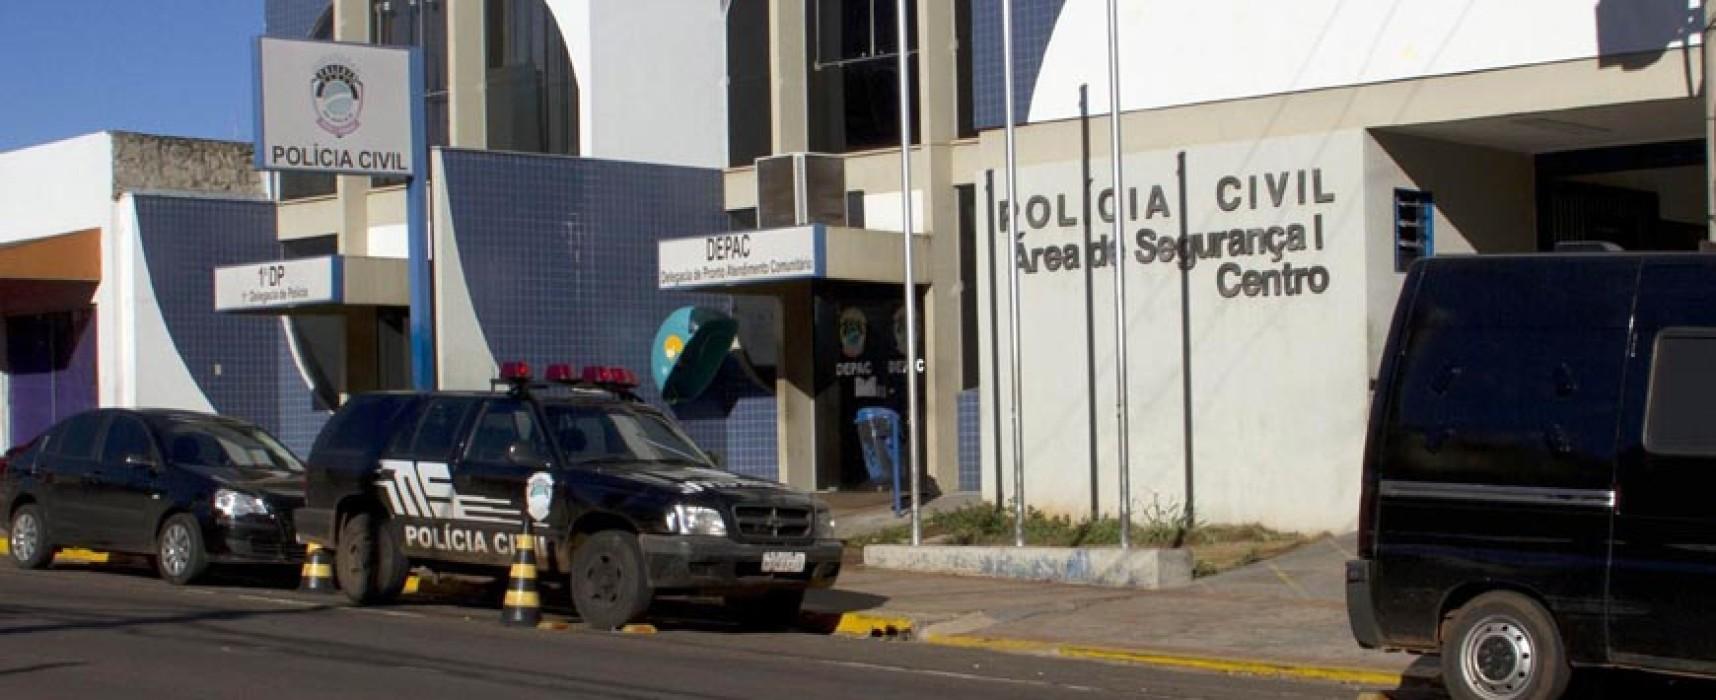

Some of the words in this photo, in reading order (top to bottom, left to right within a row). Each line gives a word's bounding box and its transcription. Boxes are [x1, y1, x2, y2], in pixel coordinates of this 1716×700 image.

[272, 144, 353, 168] POLÍCIA
[358, 151, 408, 171] CIVIL
[998, 184, 1171, 233] POLCIA
[1216, 168, 1335, 212] CIVIL
[706, 234, 750, 261] DEPAC
[1135, 222, 1306, 271] Segurança
[269, 265, 285, 287] DP
[1216, 262, 1330, 298] Centro
[405, 523, 488, 553] POLÍCIA
[494, 531, 548, 558] CIIL
